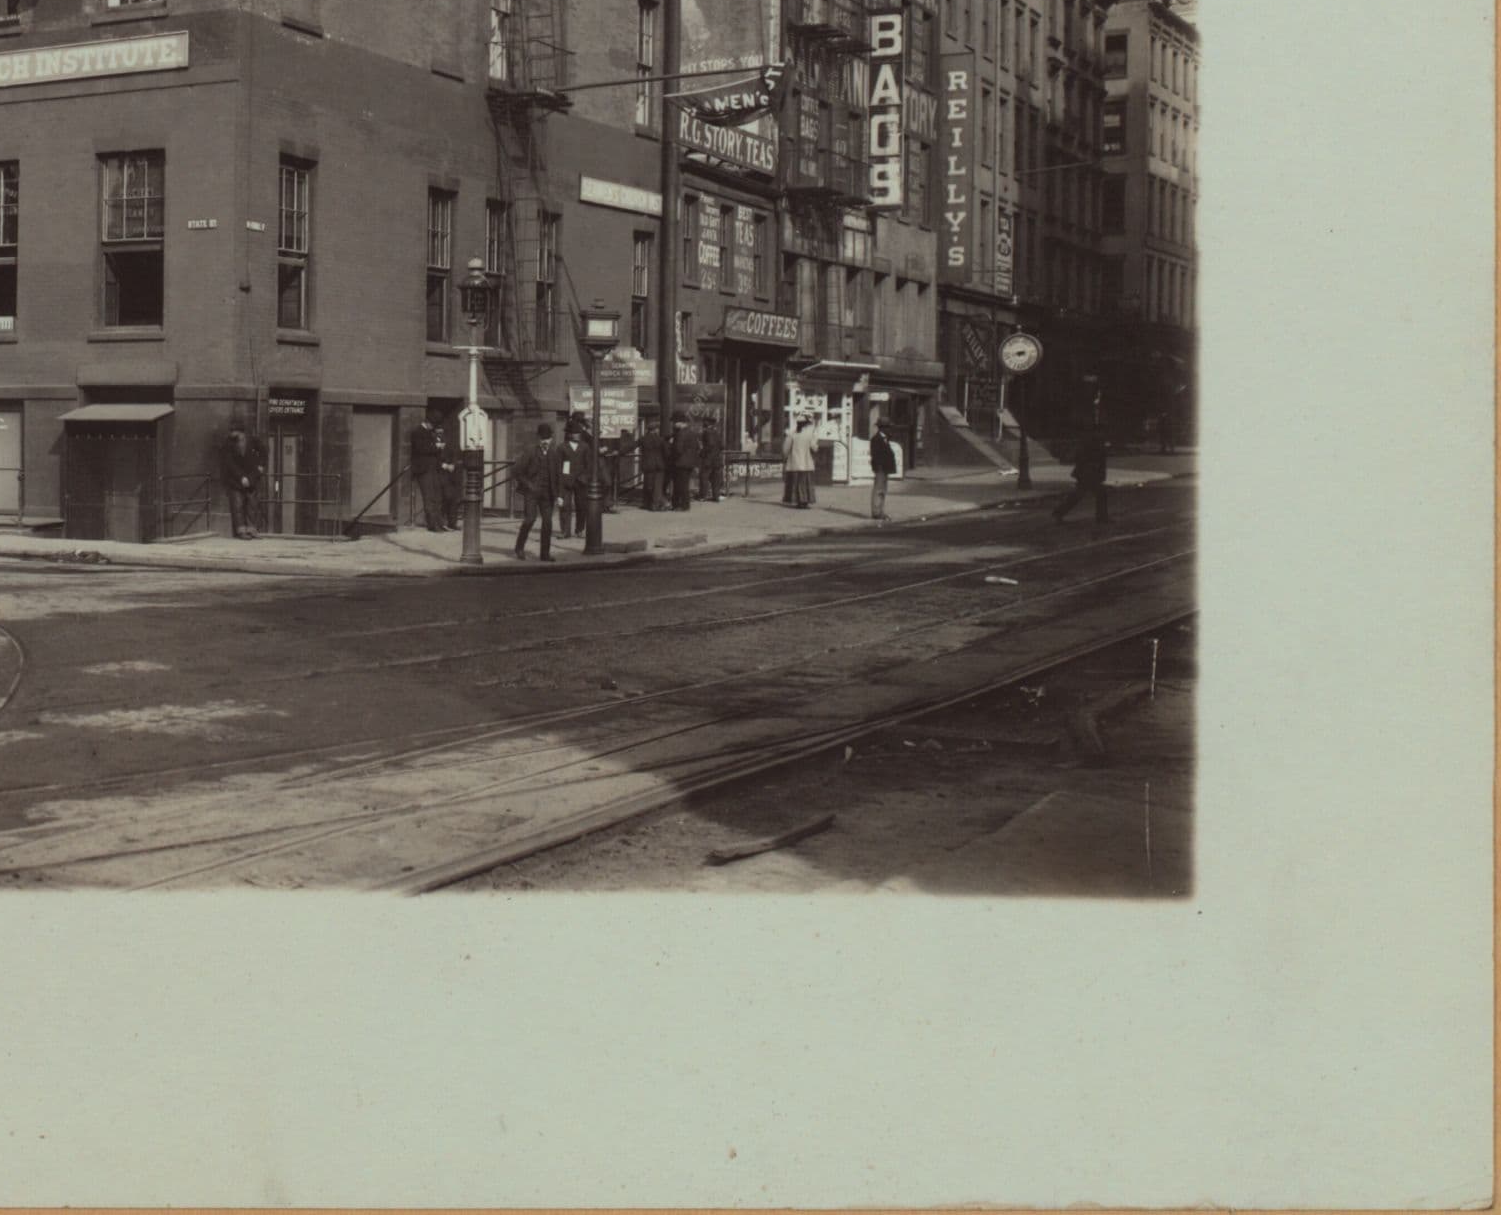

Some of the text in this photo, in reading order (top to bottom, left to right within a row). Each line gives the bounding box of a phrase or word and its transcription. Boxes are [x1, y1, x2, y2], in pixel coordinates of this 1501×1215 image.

[870, 14, 904, 205] BAGS
[746, 136, 774, 170] TEAS
[945, 71, 968, 266] REILLY'S
[735, 221, 754, 246] TEAS
[747, 312, 798, 339] COFFEES
[677, 365, 697, 385] TEAS
